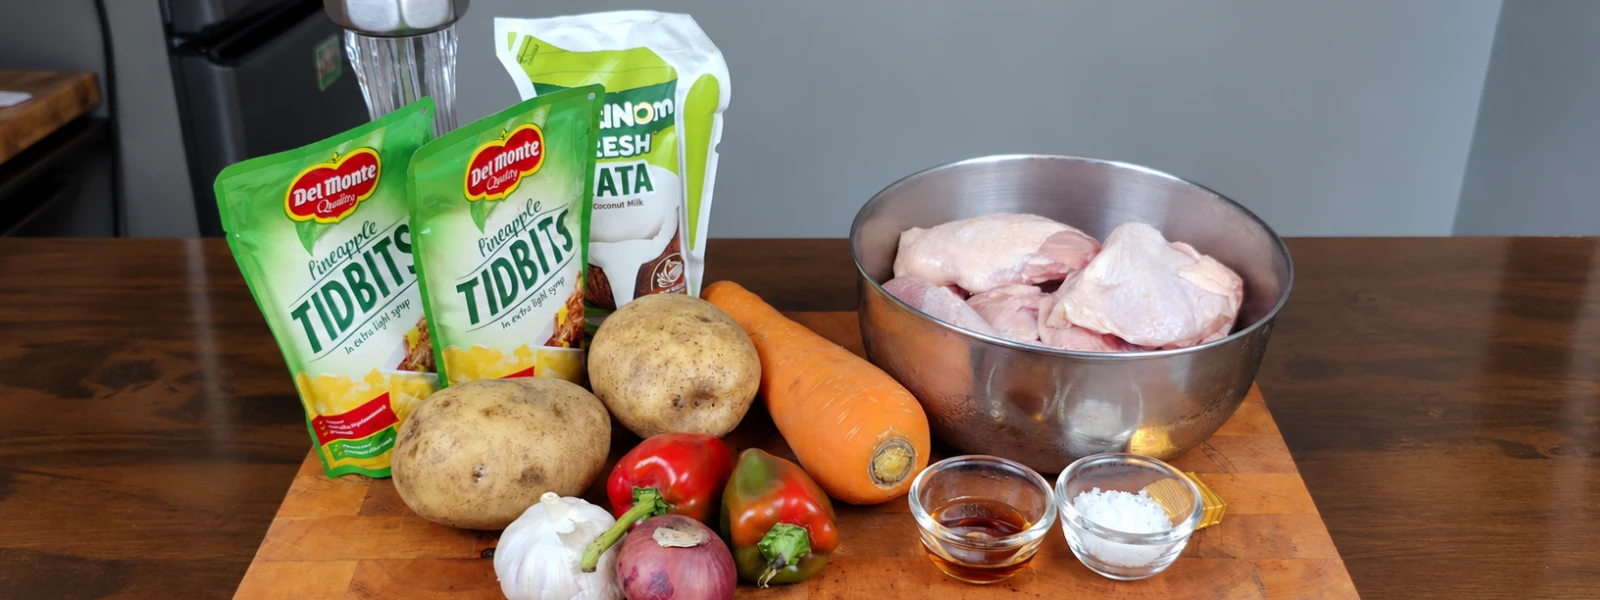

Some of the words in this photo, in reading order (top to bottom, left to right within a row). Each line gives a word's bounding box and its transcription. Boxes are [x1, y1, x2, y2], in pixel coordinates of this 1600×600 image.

[293, 183, 322, 207] Del
[324, 164, 376, 196] Monte
[471, 160, 493, 187] Del
[494, 140, 540, 173] Monte
[592, 163, 654, 197] ATA
[478, 198, 543, 257] Pineapple
[593, 202, 625, 211] Coconut
[627, 199, 644, 208] Milk
[308, 220, 378, 281] Pineapple
[456, 208, 573, 325] TIDBITS
[290, 223, 417, 354] TIDBITS
[391, 298, 411, 318] syrup
[501, 321, 511, 330] In
[512, 305, 532, 323] extra
